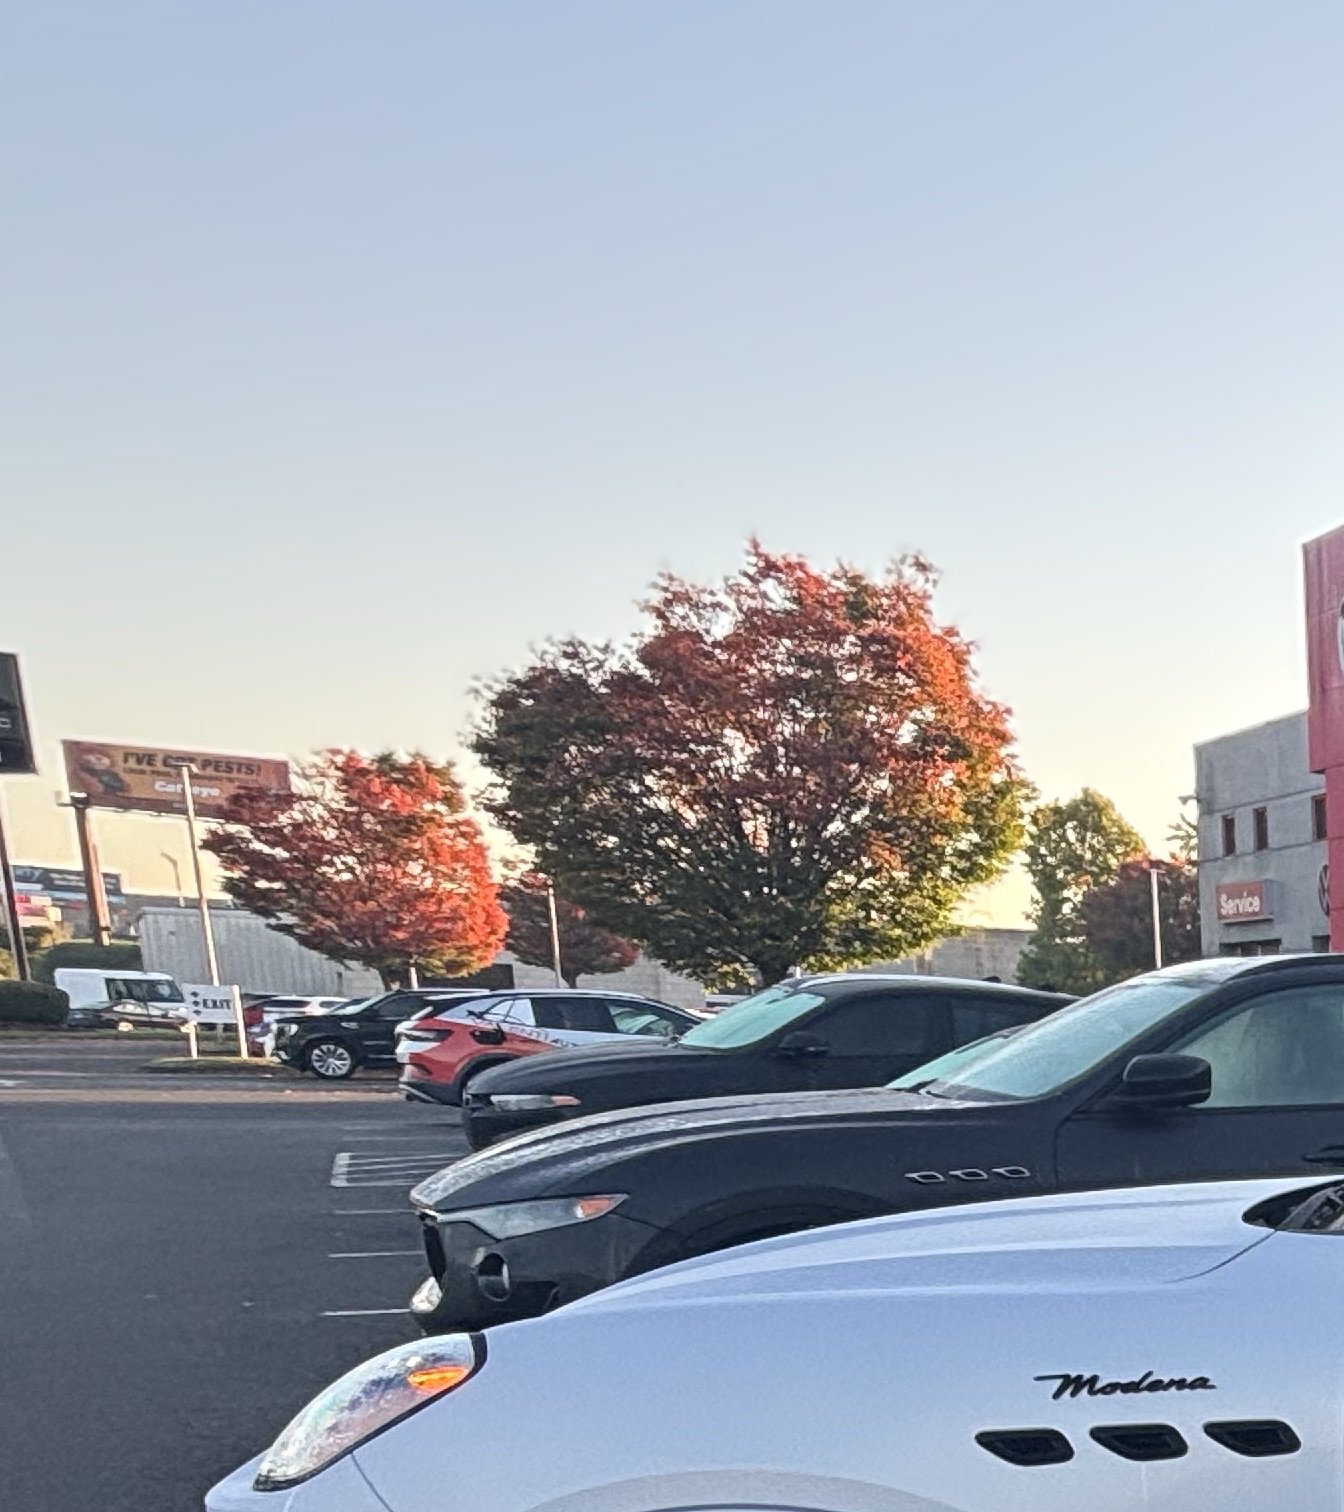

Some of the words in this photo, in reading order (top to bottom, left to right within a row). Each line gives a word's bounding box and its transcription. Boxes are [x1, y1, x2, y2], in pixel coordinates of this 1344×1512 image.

[1220, 891, 1261, 915] Service
[203, 999, 231, 1009] EXIT
[1033, 1371, 1217, 1400] Modena
